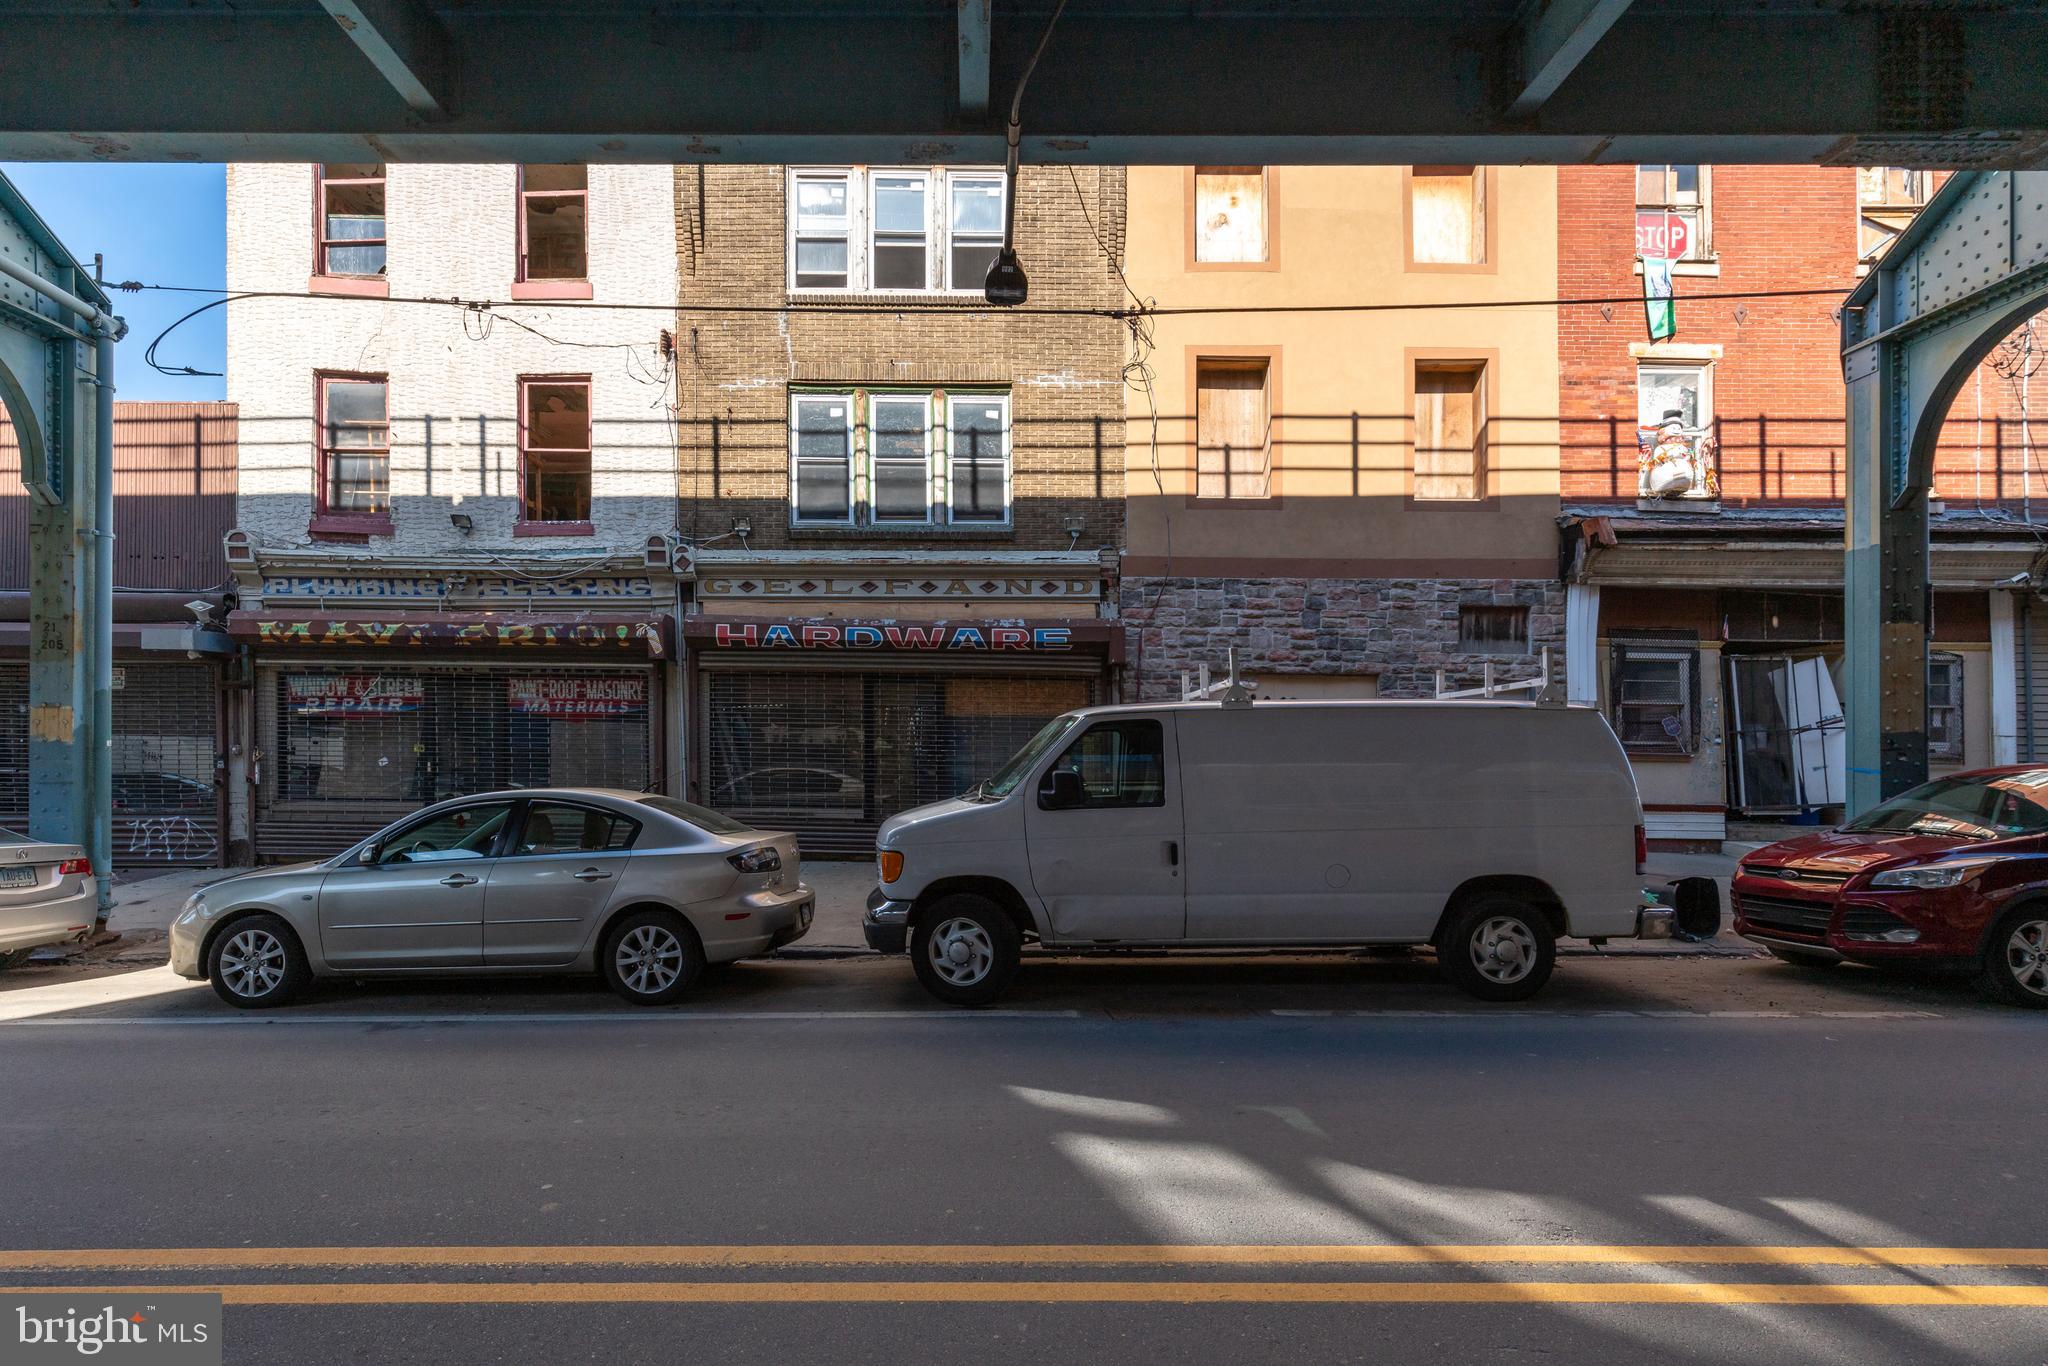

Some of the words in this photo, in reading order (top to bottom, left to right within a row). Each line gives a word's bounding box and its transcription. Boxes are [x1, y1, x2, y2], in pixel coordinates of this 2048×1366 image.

[1636, 226, 1685, 249] STOP
[269, 577, 443, 596] PLUMBING
[483, 578, 652, 596] ELECTRIC
[43, 622, 56, 632] 21
[41, 640, 64, 650] 205
[716, 624, 1073, 650] HARDWARE
[288, 677, 349, 697] WINDOW
[355, 679, 366, 695] &
[369, 679, 422, 697] SCREEN
[305, 697, 404, 712] REPAIR
[523, 701, 630, 714] MATERIALS
